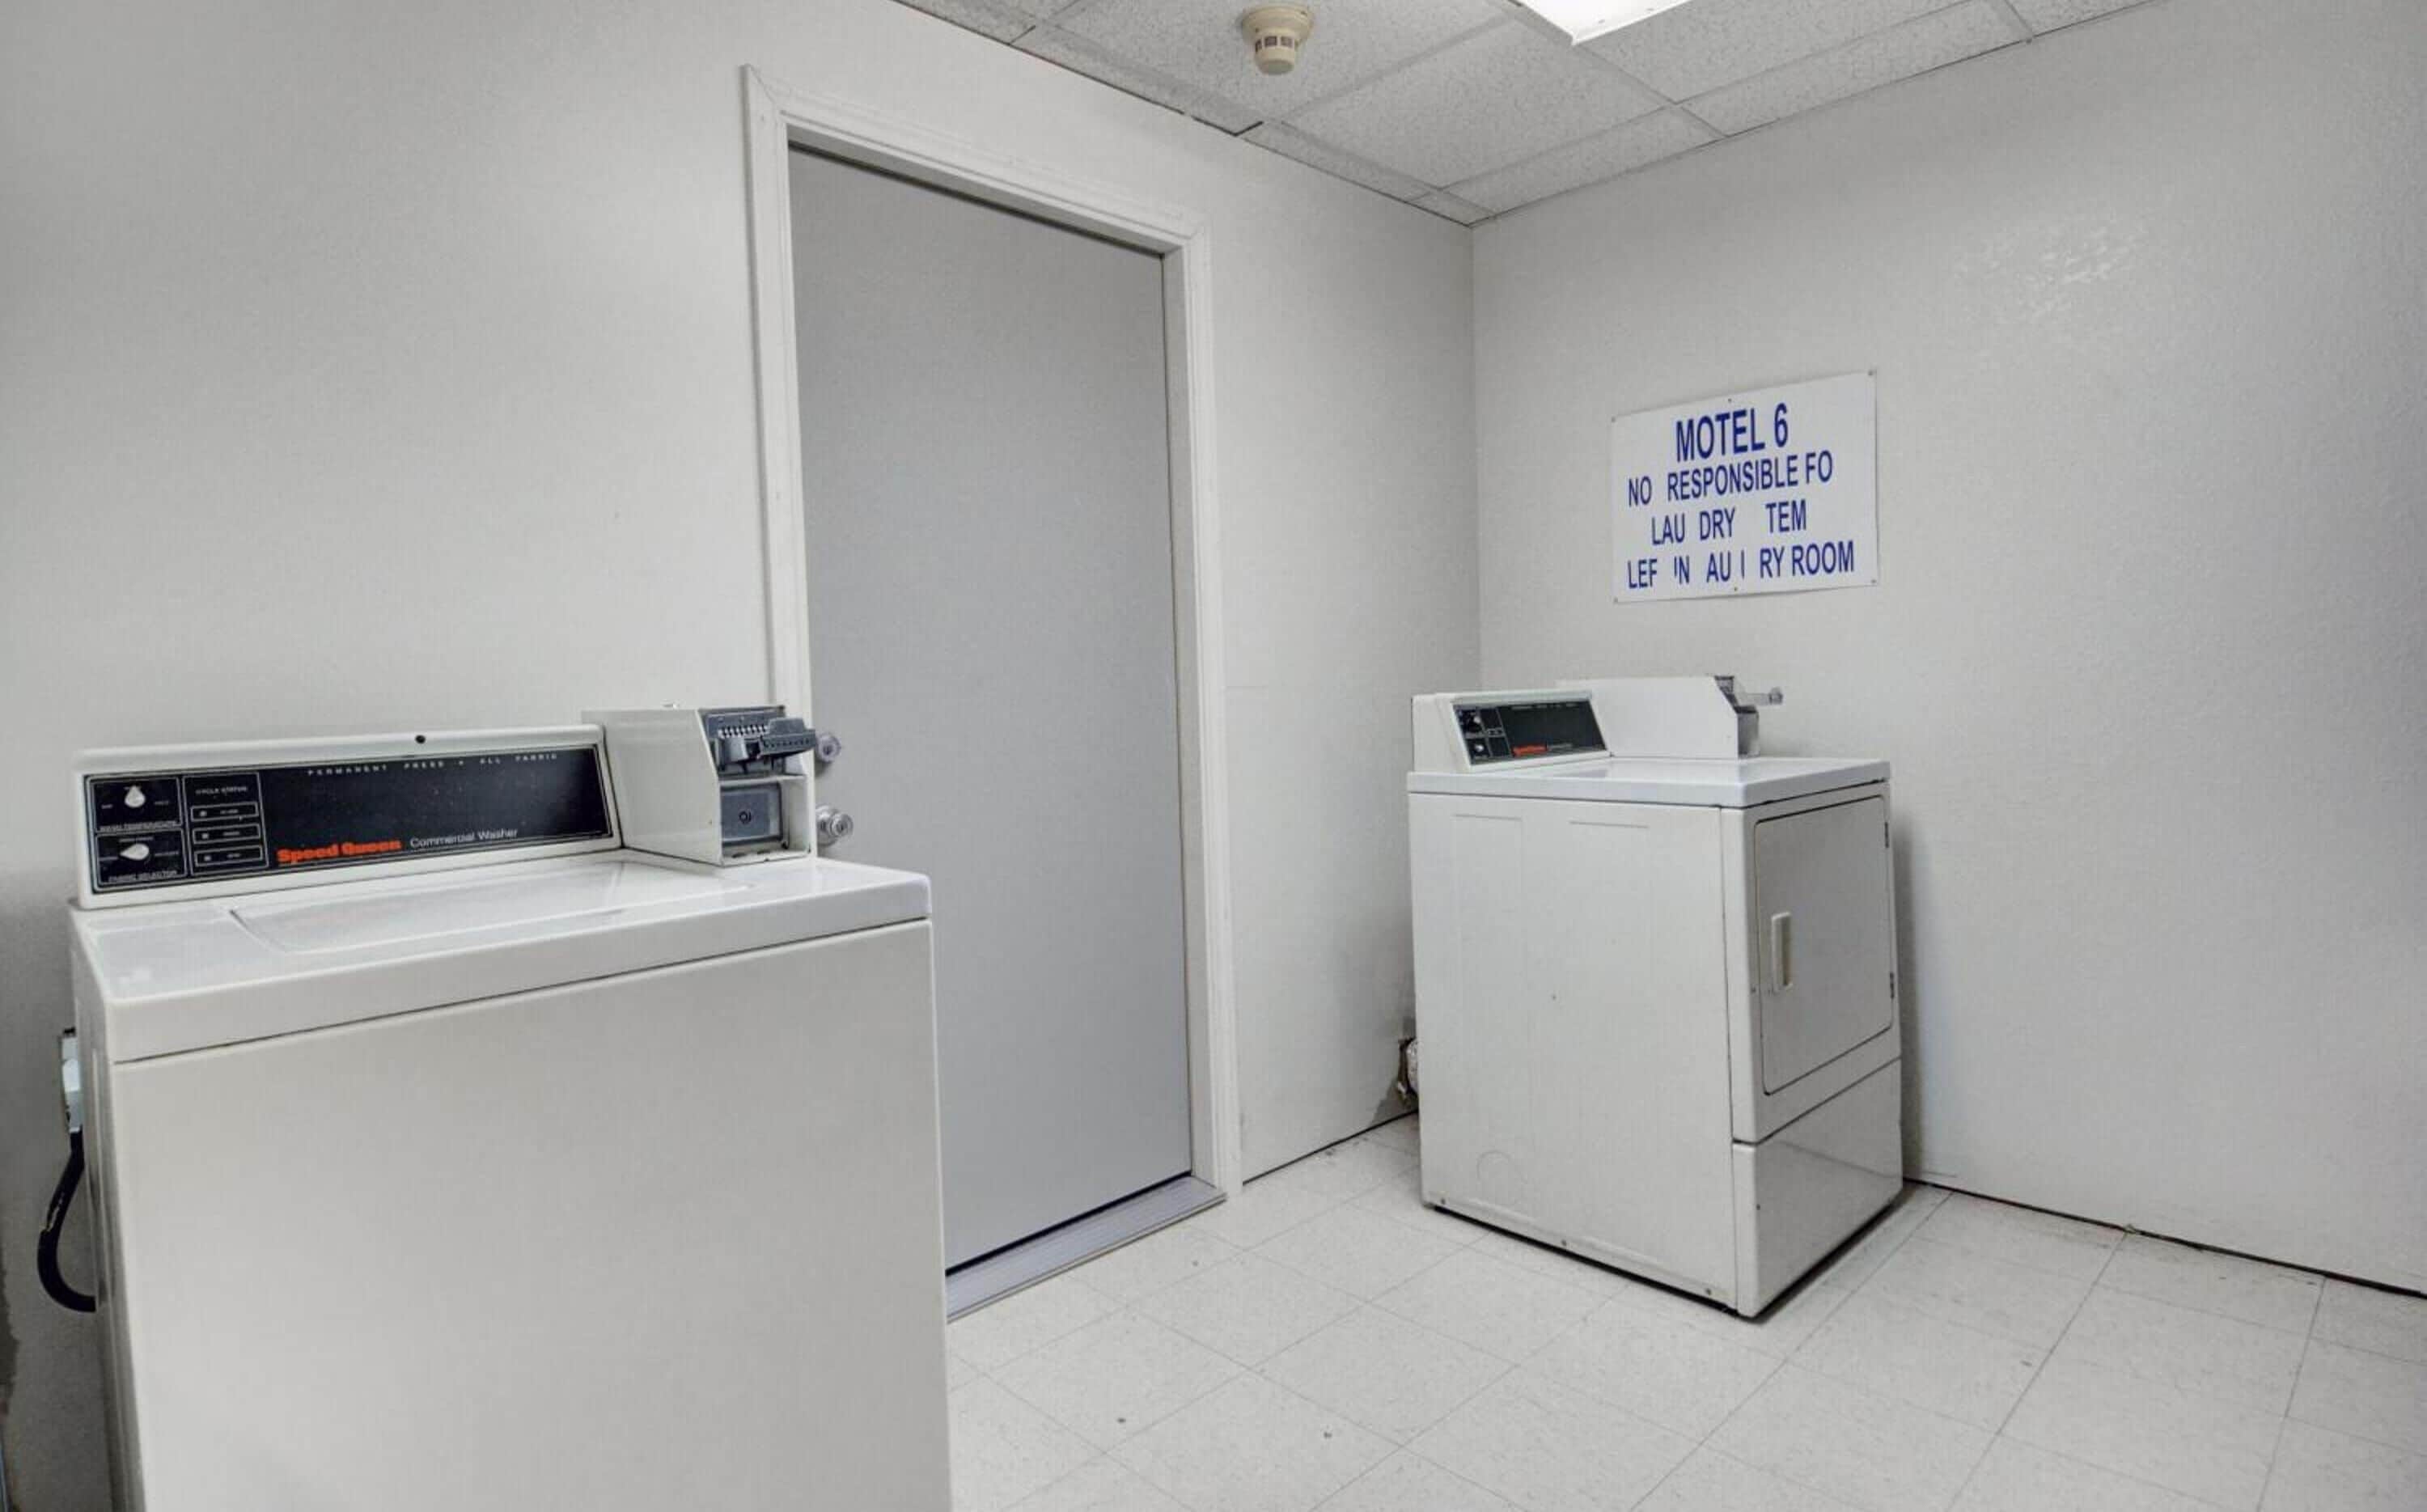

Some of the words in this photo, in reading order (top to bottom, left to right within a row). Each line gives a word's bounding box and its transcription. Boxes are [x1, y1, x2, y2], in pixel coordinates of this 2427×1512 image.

[1675, 408, 1766, 462] MOTEL
[1773, 402, 1789, 448] 6
[1667, 454, 1799, 502] RESPONSIBLE
[1791, 540, 1855, 577] ROOM
[277, 842, 339, 865] Speed
[341, 839, 402, 858] Queen
[410, 832, 475, 849] Commercial
[477, 827, 519, 841] Washer
